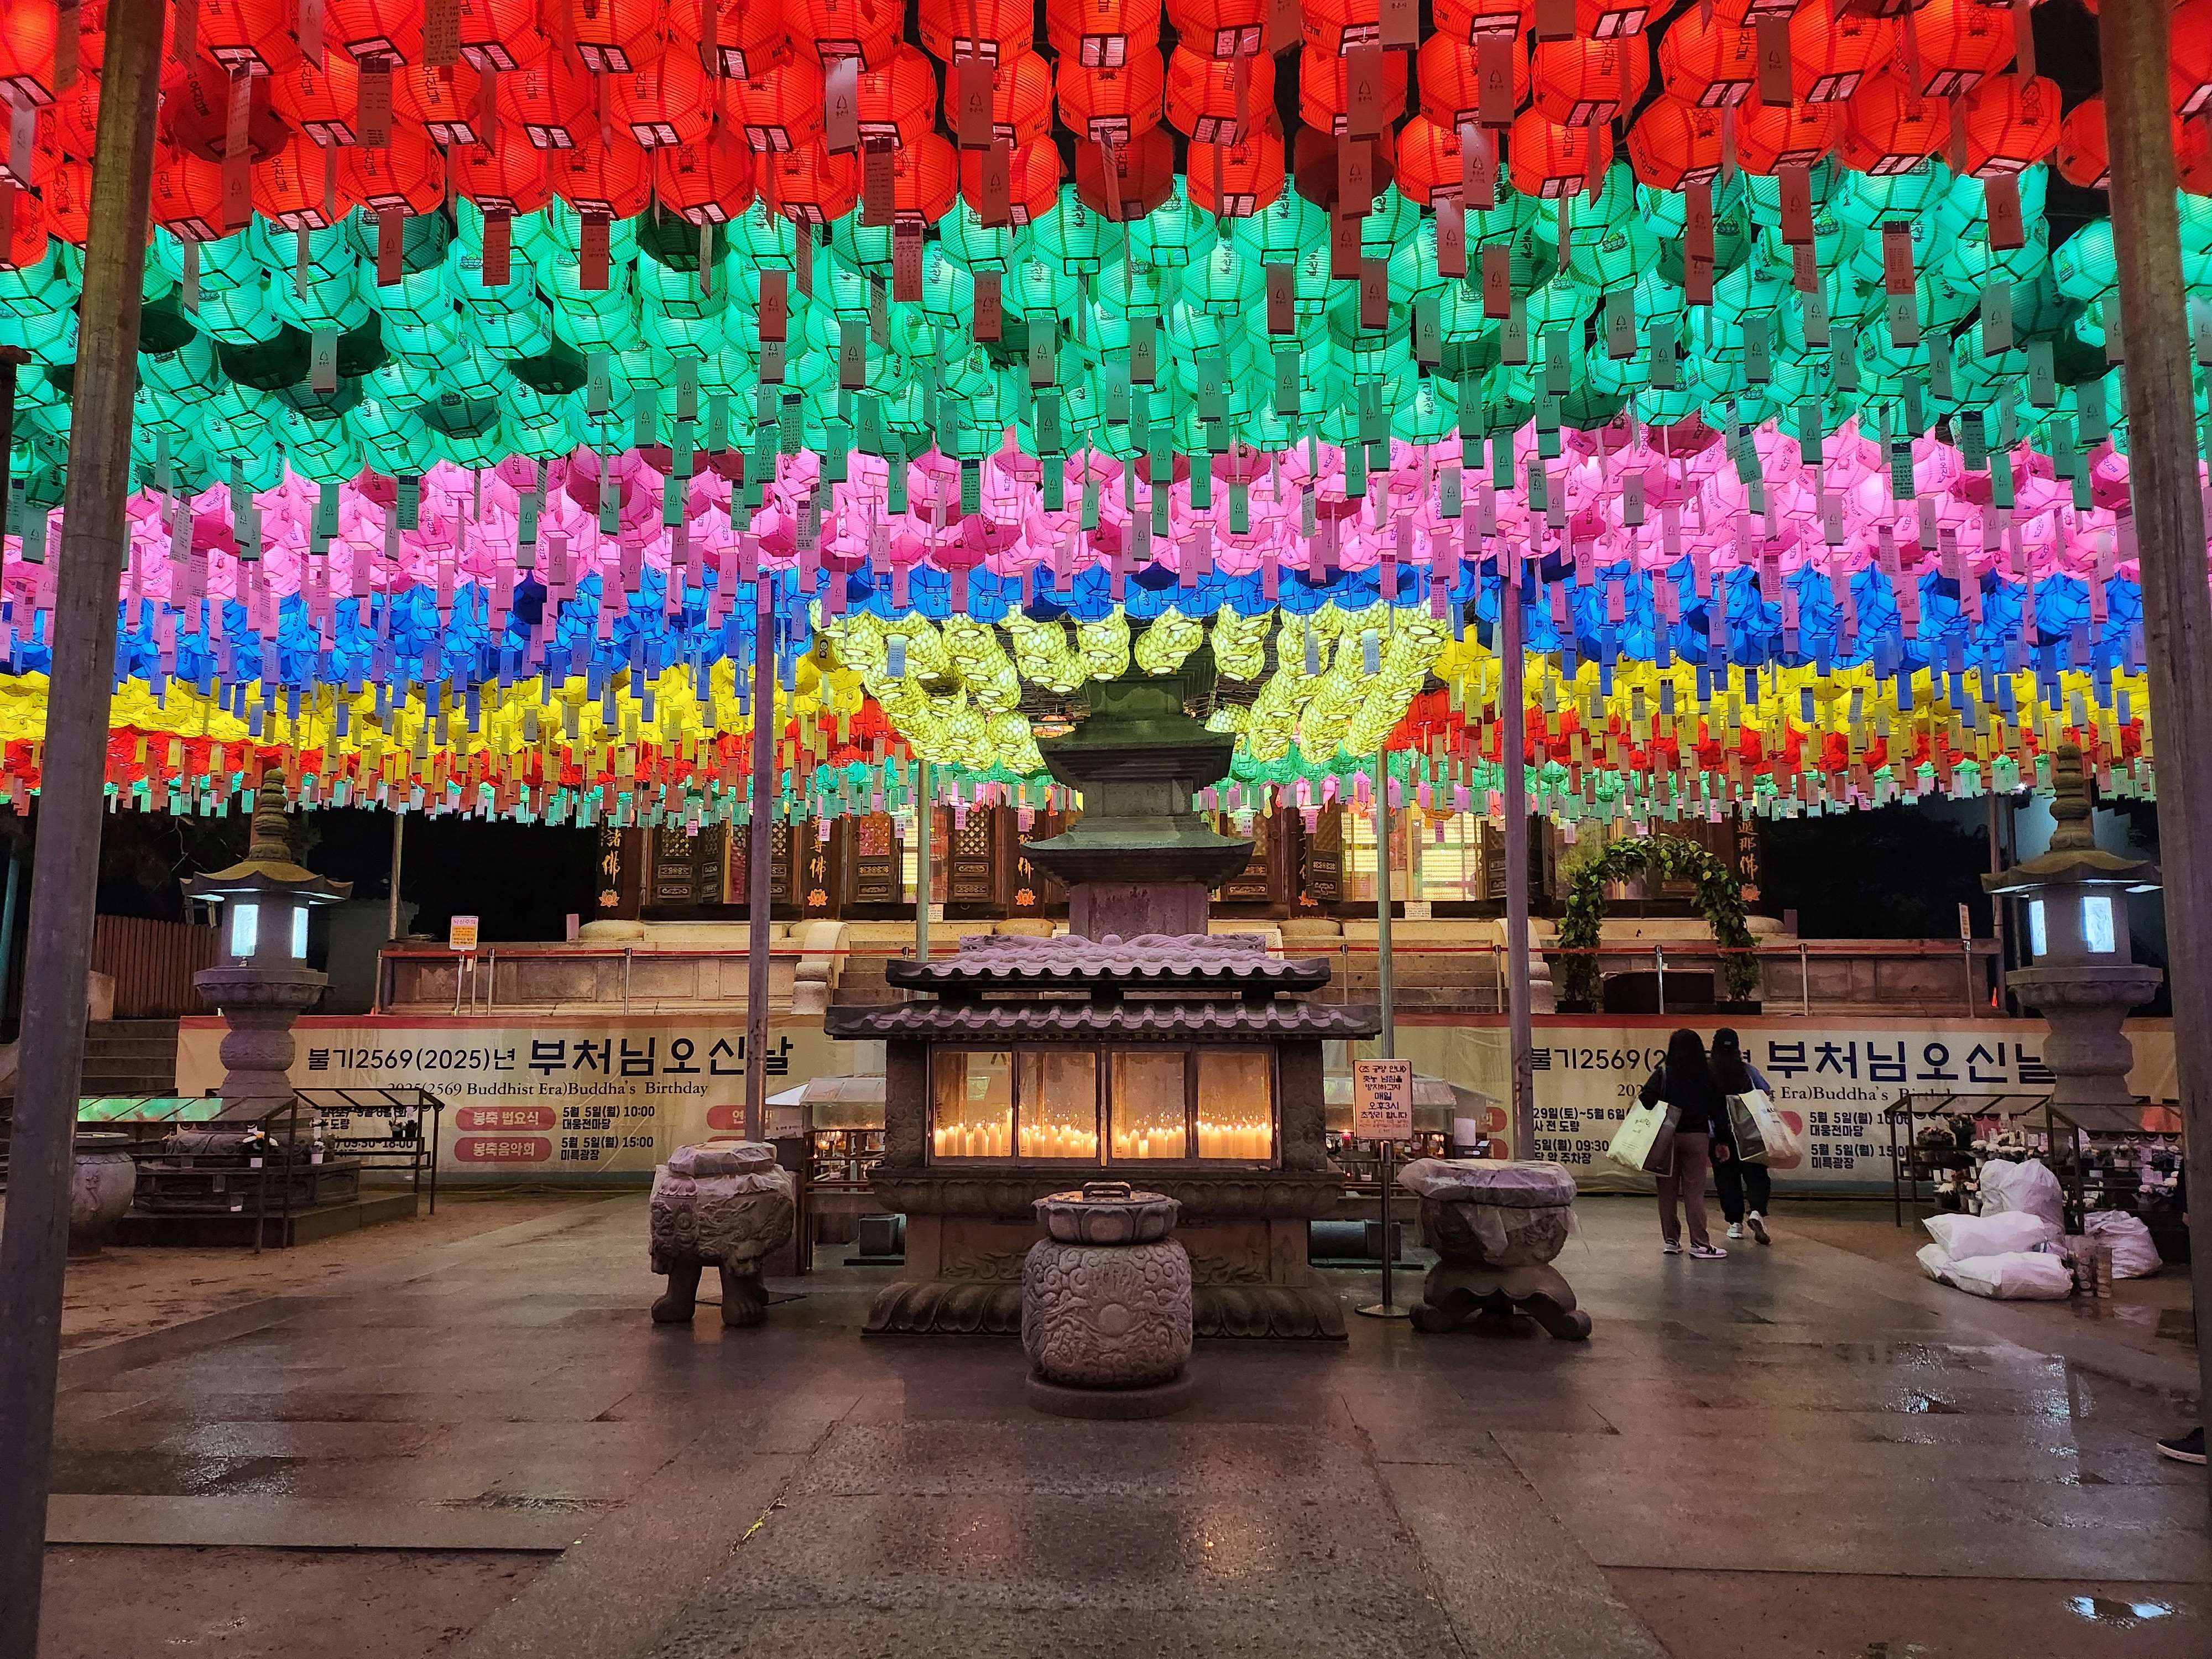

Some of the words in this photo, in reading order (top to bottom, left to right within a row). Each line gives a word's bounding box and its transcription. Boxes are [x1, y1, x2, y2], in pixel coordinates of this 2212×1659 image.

[1735, 30, 1750, 60] 신날
[524, 70, 539, 100] 신날
[634, 71, 648, 99] 신날
[1562, 127, 1575, 158] 신날
[363, 148, 377, 176] 신날
[159, 171, 174, 199] 신날
[308, 1047, 515, 1071] 불기2569(2025)년
[529, 1036, 794, 1076] 부처님오신날
[467, 1082, 534, 1095] Buddhist
[538, 1081, 635, 1096] Era)Buddha's
[645, 1081, 708, 1097] Birthday
[1781, 1086, 1888, 1101] Era)Buddha's
[1375, 1092, 1392, 1100] 매일
[563, 1106, 580, 1118] 5월
[585, 1106, 620, 1118] 5일(월)
[624, 1106, 655, 1118] 10:00
[1368, 1102, 1399, 1110] 오후3시
[473, 1111, 498, 1125] 봉축
[502, 1111, 539, 1126] 법요식
[1608, 1108, 1630, 1120] 6일(
[1810, 1111, 1828, 1124] 5월
[1834, 1111, 1873, 1125] 5일(월)
[331, 1119, 350, 1129] 도량
[562, 1118, 611, 1130] 대웅전마당
[1559, 1120, 1580, 1132] 도량
[1810, 1124, 1864, 1137] 대웅전마당
[473, 1142, 535, 1156] 봉축음악회
[561, 1136, 578, 1149] 5월
[583, 1136, 619, 1149] 5일(월)
[622, 1136, 654, 1148] 15:00
[1535, 1139, 1572, 1151] 5일(월)
[561, 1149, 599, 1161] 미륵광장
[1811, 1144, 1829, 1156] 5월
[1835, 1144, 1874, 1157] 5일(월)
[1560, 1152, 1592, 1164] 주차장
[1811, 1157, 1854, 1169] 미륵광장
